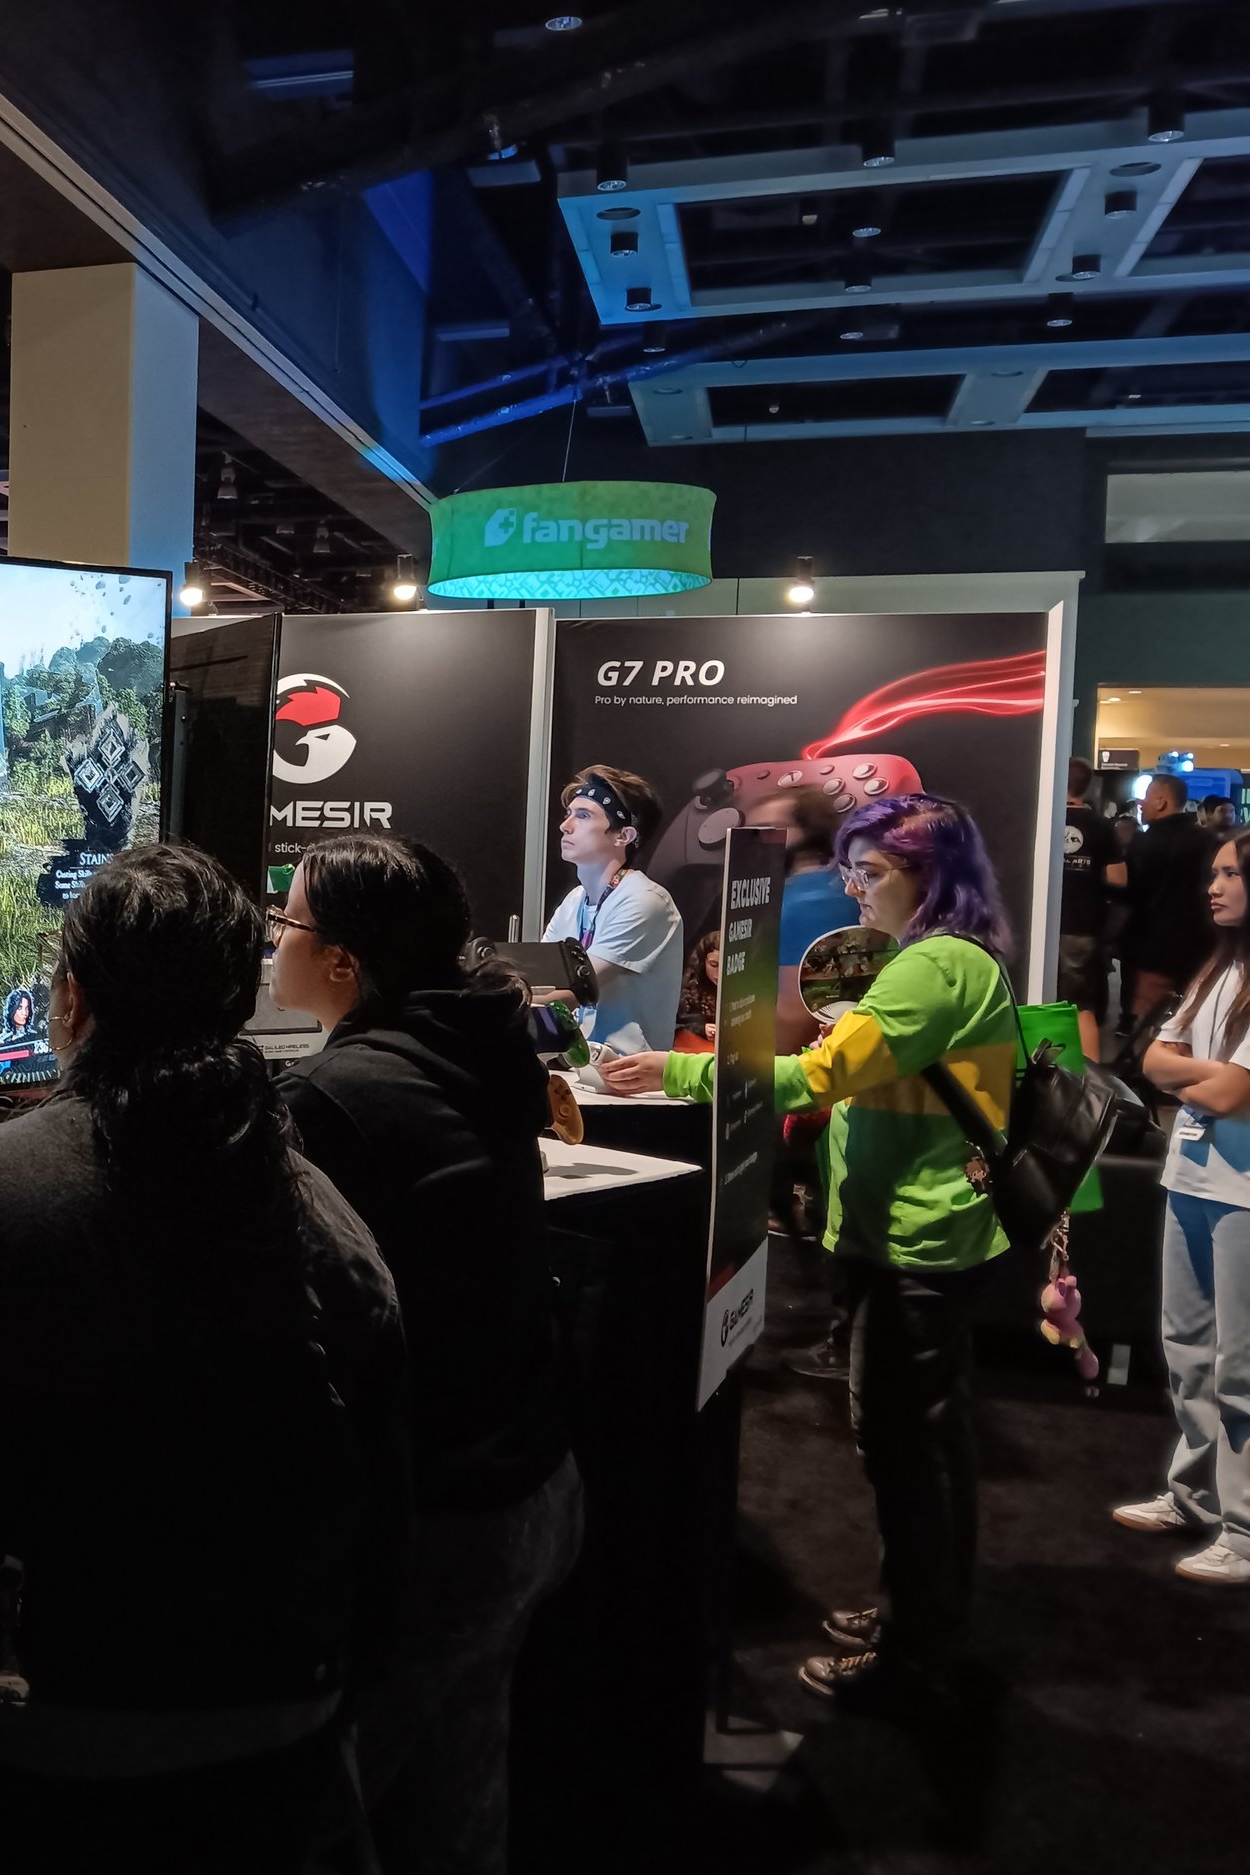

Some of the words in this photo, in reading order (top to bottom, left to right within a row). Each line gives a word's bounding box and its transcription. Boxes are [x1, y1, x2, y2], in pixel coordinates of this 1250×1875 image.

[523, 512, 690, 549] fangamer
[597, 660, 643, 687] G7
[651, 659, 725, 687] PRO
[594, 695, 612, 705] Pro
[613, 695, 627, 707] by
[629, 695, 665, 705] nature,
[667, 694, 735, 707] performance
[737, 695, 798, 707] reimagined
[730, 876, 771, 910] EXCLUSIVE
[726, 951, 746, 976] BADGE
